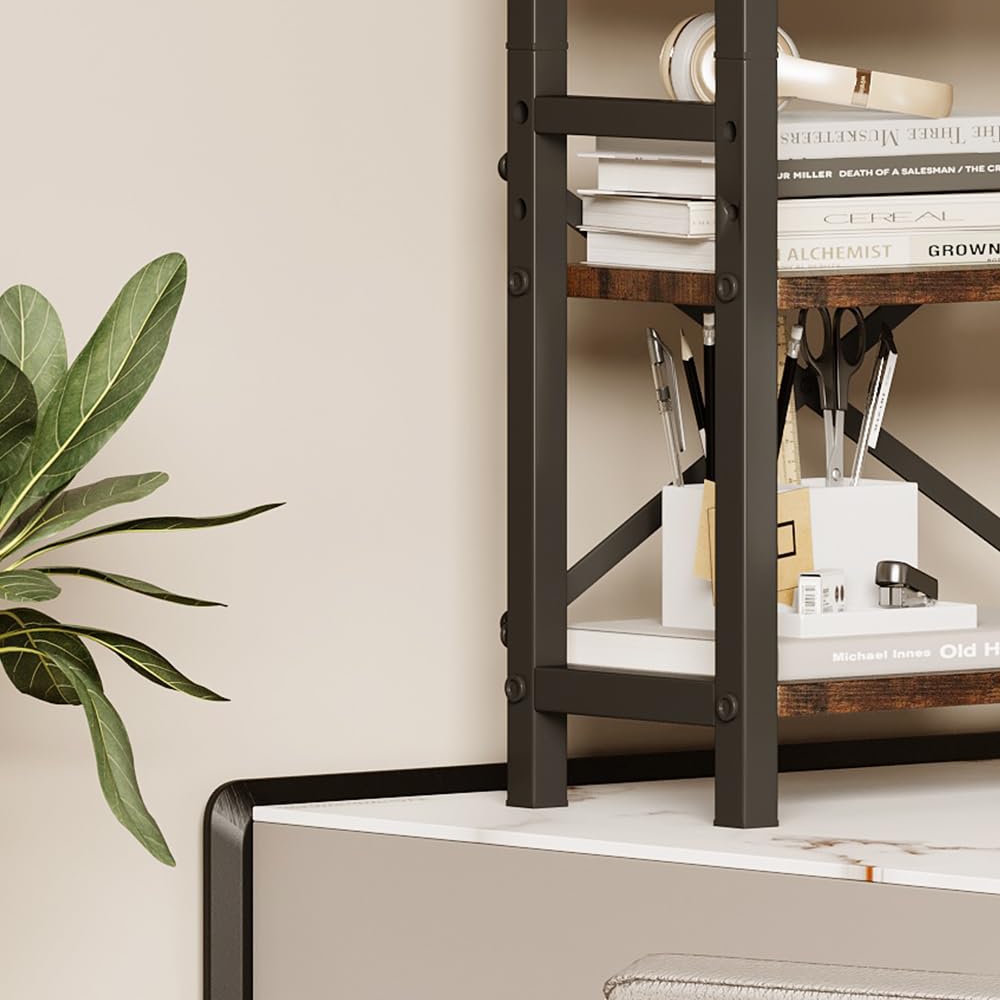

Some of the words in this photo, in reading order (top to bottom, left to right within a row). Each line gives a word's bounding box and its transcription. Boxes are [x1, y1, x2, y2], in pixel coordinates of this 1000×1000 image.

[793, 170, 833, 180] MILLER
[838, 168, 874, 178] DEATH
[891, 167, 900, 176] A
[901, 166, 956, 176] SALESMAN
[964, 164, 986, 173] THE
[787, 244, 892, 261] ALCHEMIST
[929, 243, 1000, 256] GROWN
[832, 649, 888, 662] Michael
[892, 647, 931, 659] Innes
[939, 642, 977, 660] Old
